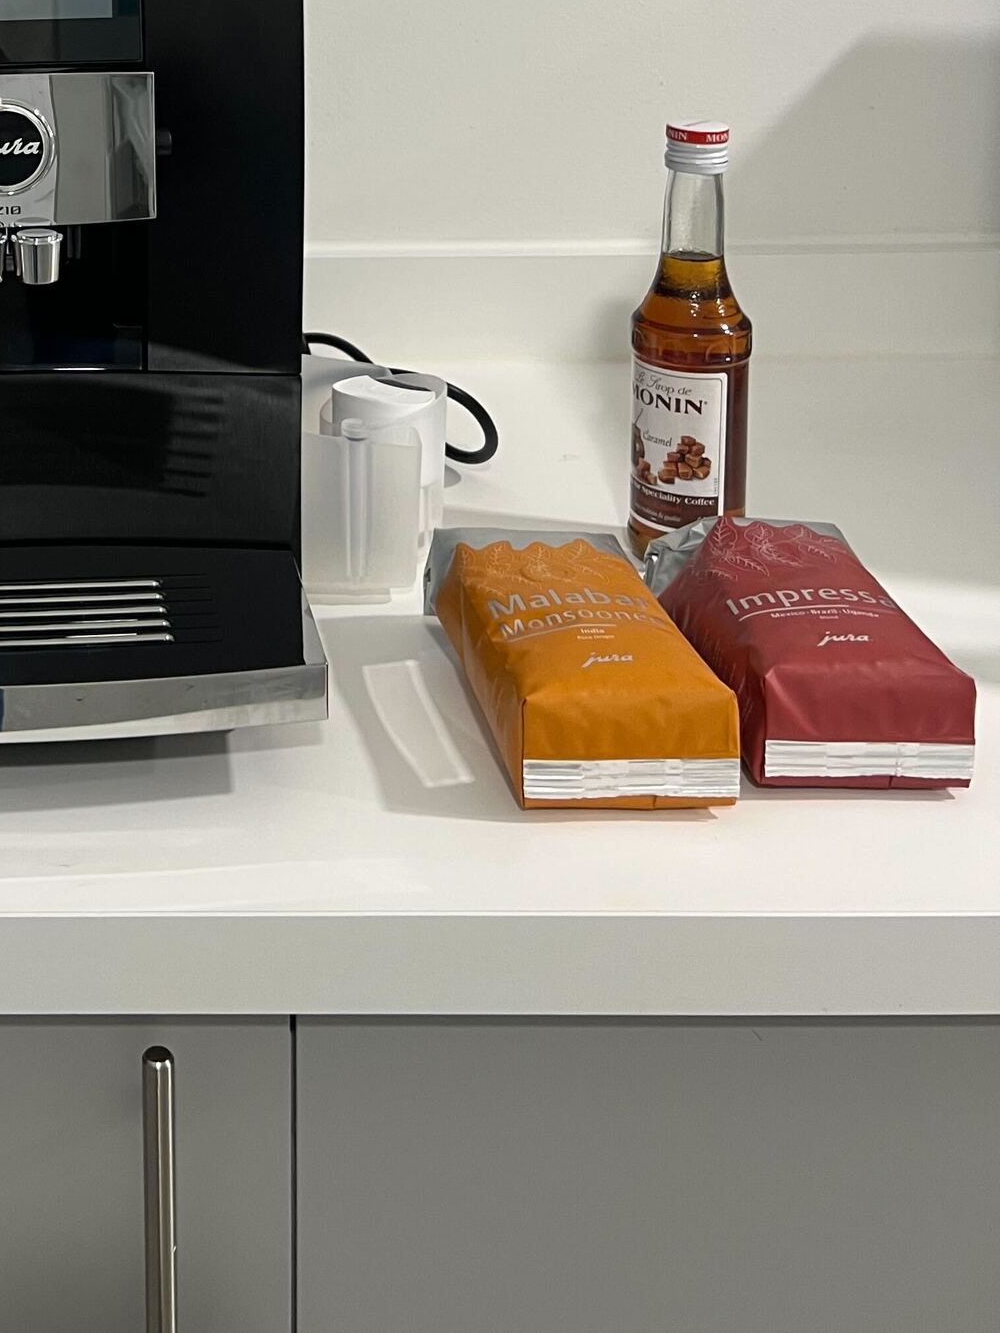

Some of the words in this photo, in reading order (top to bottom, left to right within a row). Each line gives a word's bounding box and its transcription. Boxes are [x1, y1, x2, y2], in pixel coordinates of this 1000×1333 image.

[646, 376, 675, 396] Sirop
[677, 386, 692, 396] de
[643, 429, 672, 447] Caramel
[641, 486, 681, 504] Speciality
[684, 497, 715, 506] Coffee
[817, 631, 870, 647] jura
[581, 652, 633, 668] jura
